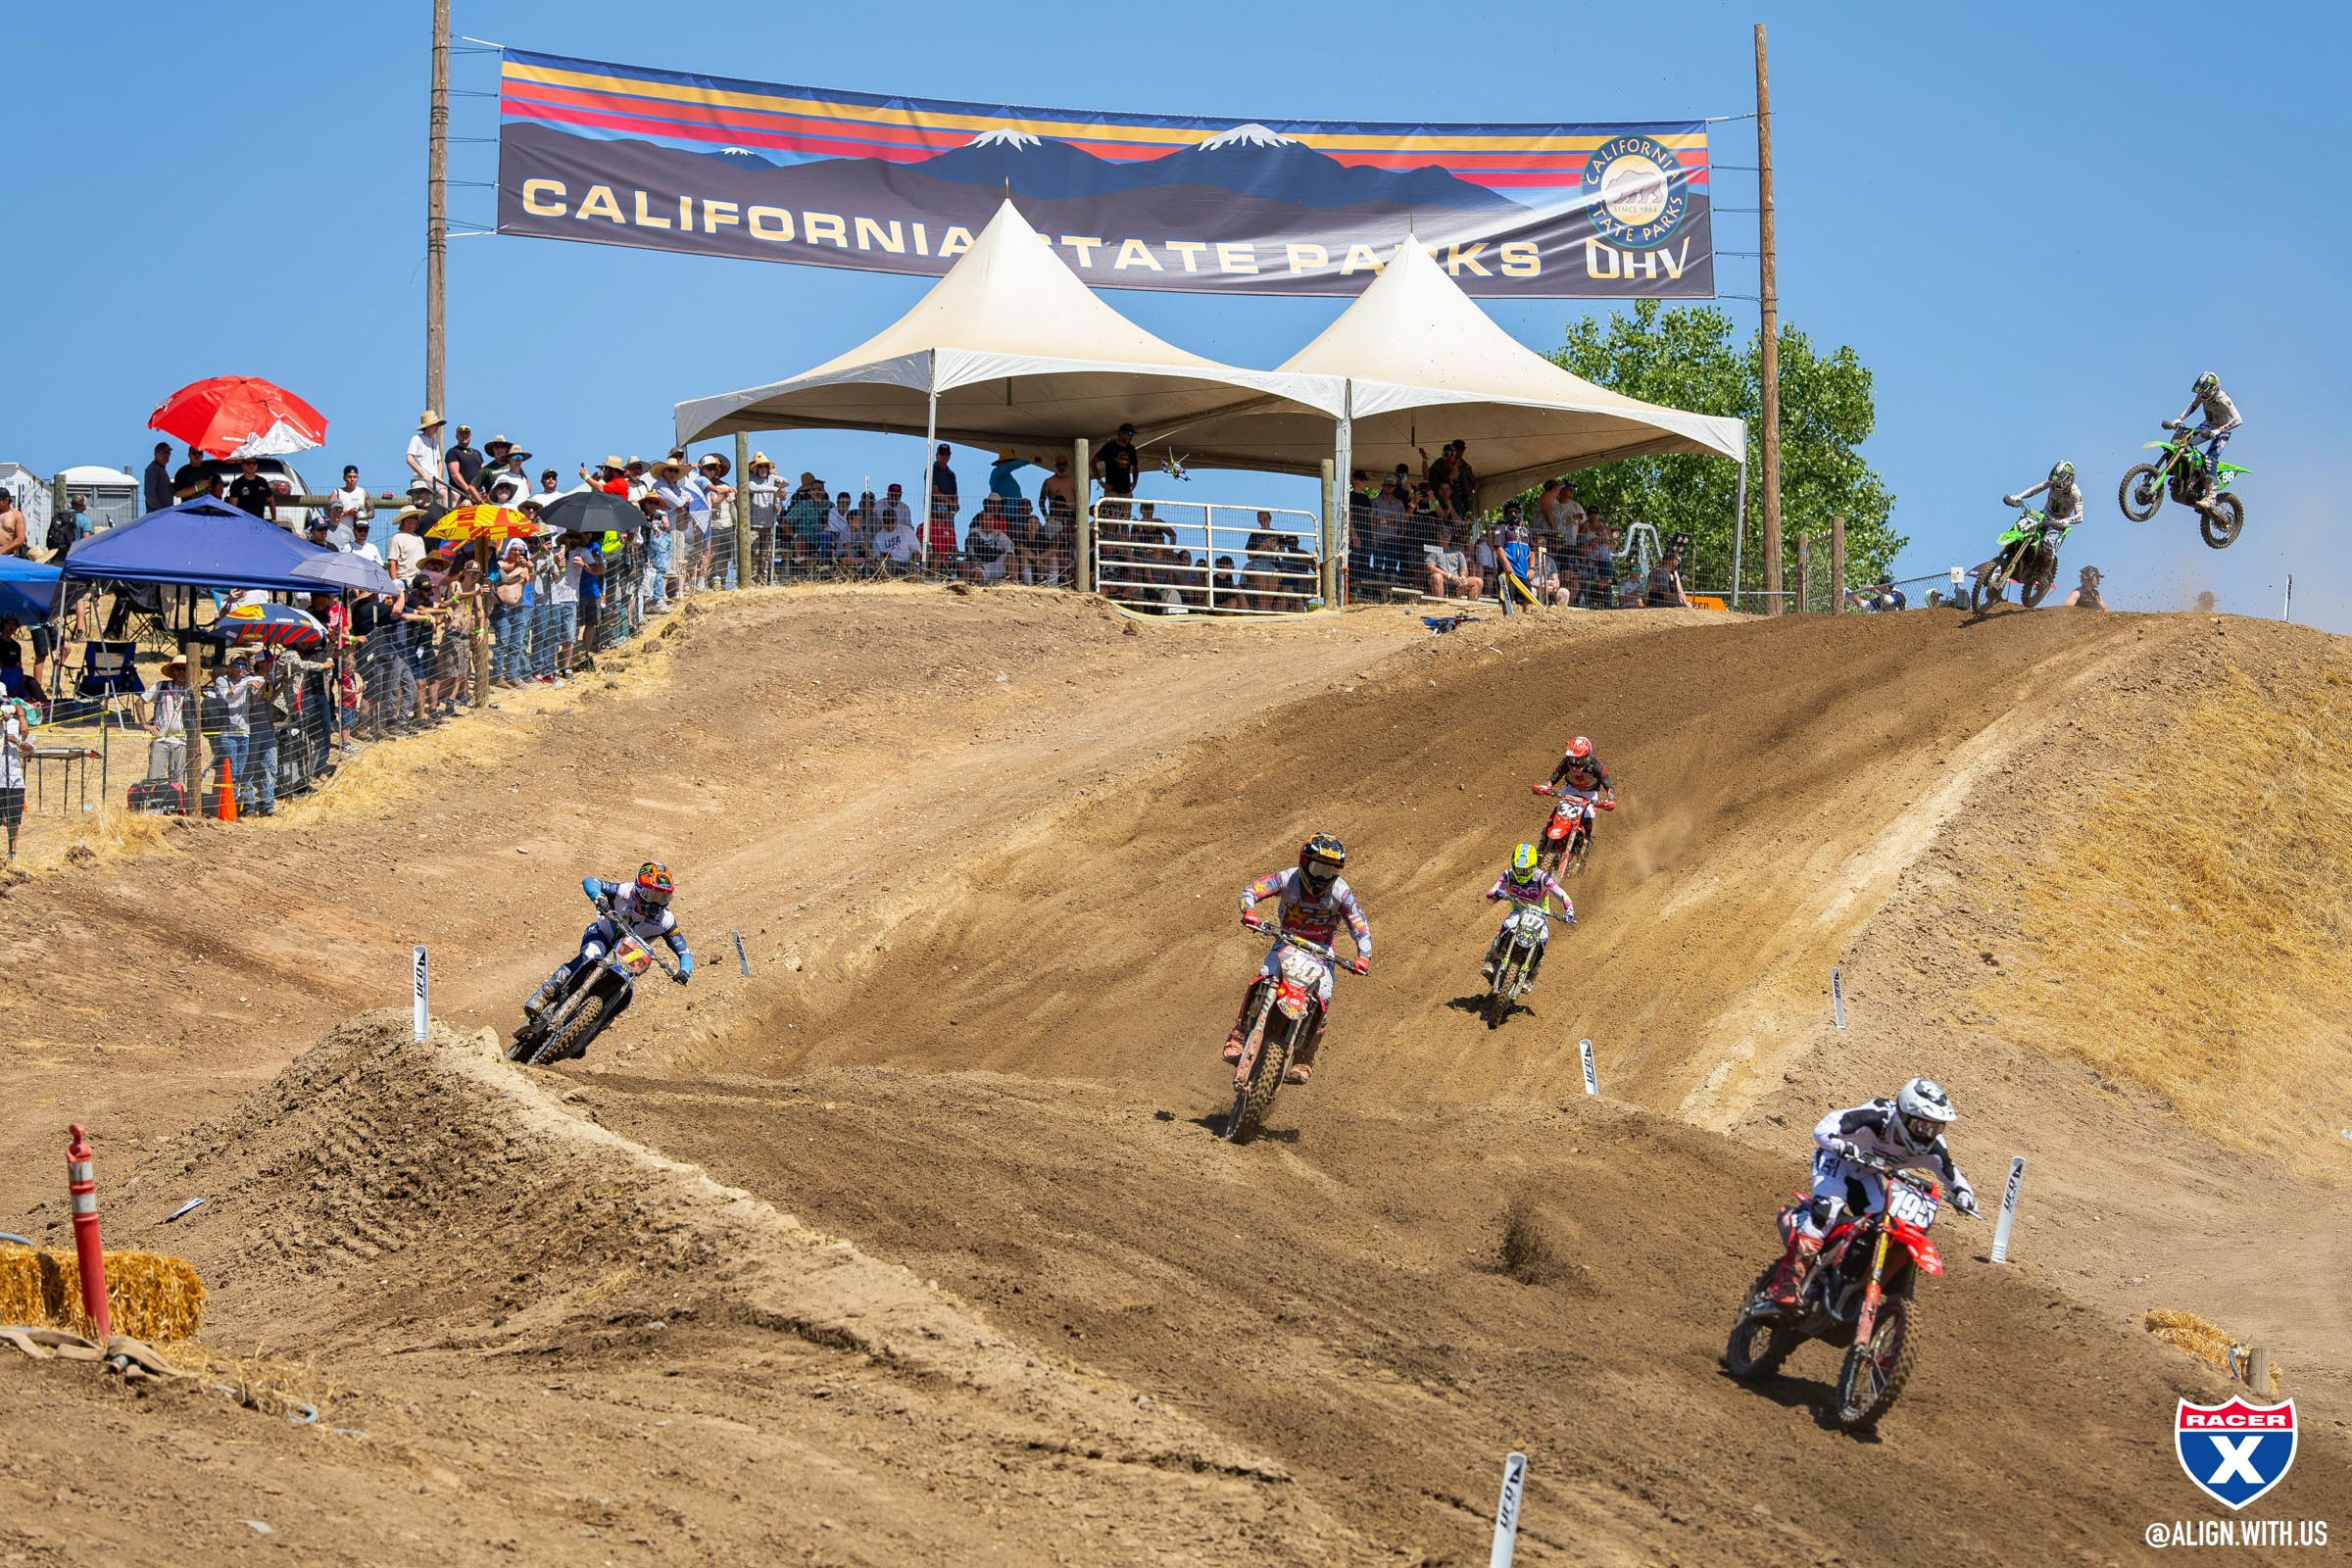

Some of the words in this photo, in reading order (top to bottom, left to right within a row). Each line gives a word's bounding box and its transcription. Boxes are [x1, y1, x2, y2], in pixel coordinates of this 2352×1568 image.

[1586, 138, 1681, 185] CALIFORNIA
[521, 176, 978, 259] CALIFORNIA
[1043, 232, 1259, 276] TATE
[1642, 196, 1683, 242] PARKS
[1585, 235, 1691, 279] OHV
[1584, 1057, 1593, 1084] UFO
[2004, 1178, 2015, 1211] UFO
[1499, 1484, 1514, 1529] UFO
